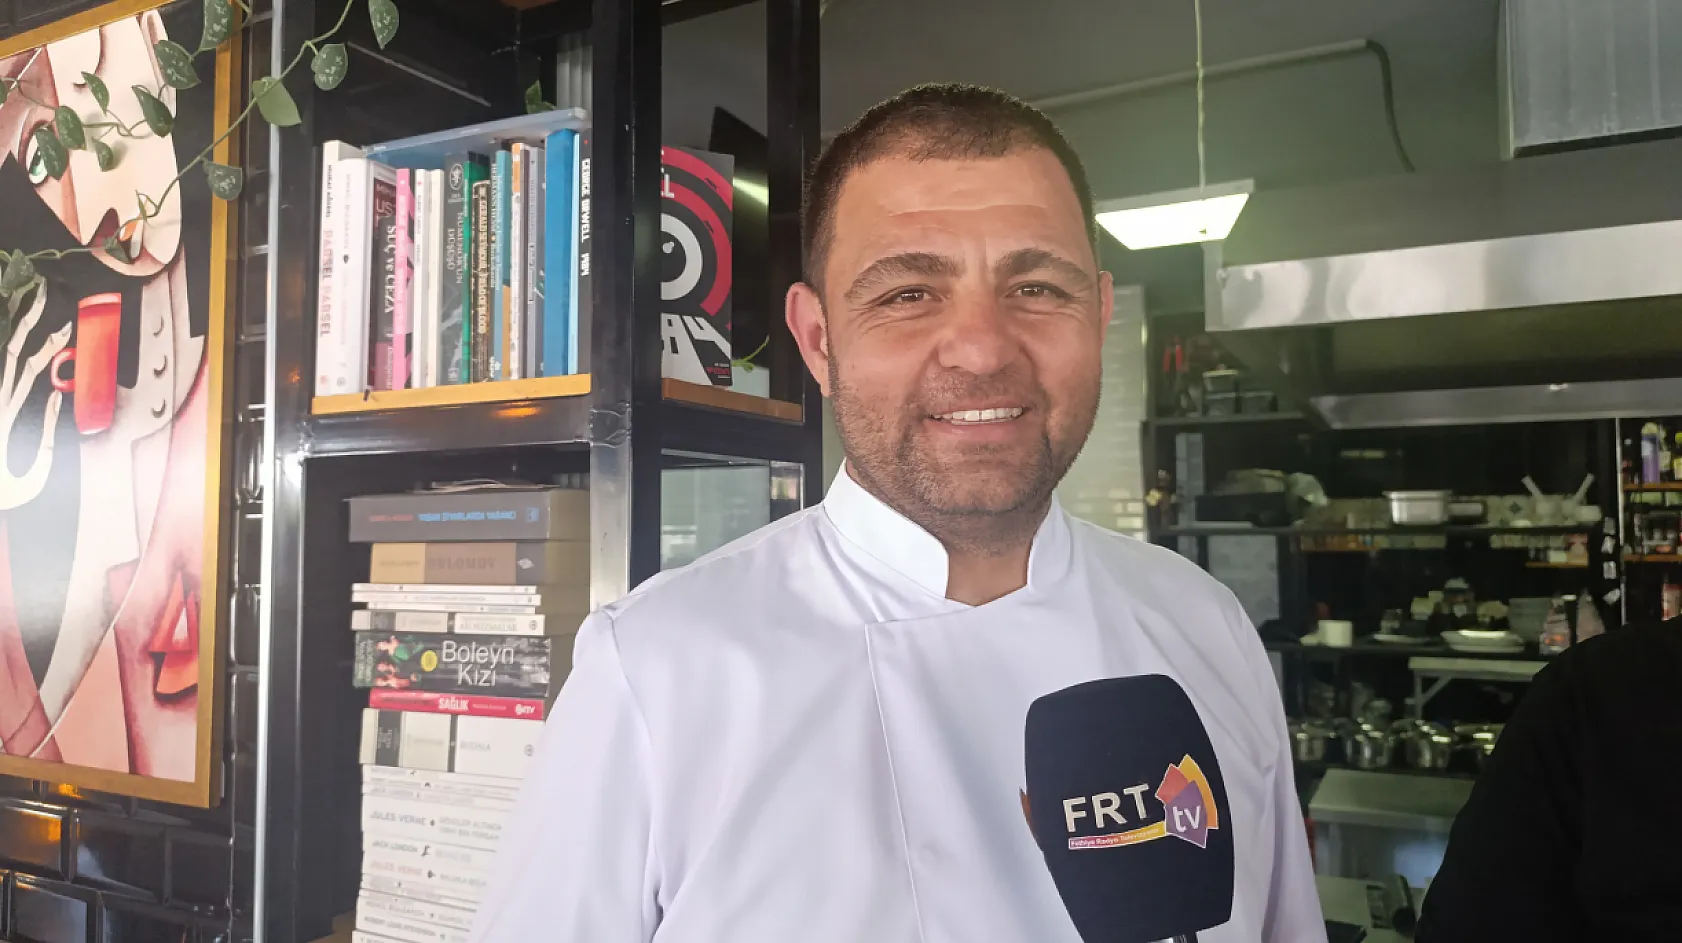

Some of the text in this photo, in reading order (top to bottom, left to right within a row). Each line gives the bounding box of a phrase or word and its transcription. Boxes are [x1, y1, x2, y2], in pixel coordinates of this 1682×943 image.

[479, 200, 488, 231] GERALD
[580, 158, 591, 276] GEORGE ORWELL 1984
[383, 225, 396, 313] SUÇ ve CEZA
[320, 229, 334, 338] PARSEL PARSEL
[478, 307, 488, 334] BLOOD
[427, 556, 497, 570] OBLOMOV
[442, 640, 514, 668] Boleyn
[438, 696, 469, 710] SAĞLIK
[370, 811, 427, 827] JULES VERNE
[1063, 783, 1150, 833] FRT
[1172, 805, 1200, 832] tv
